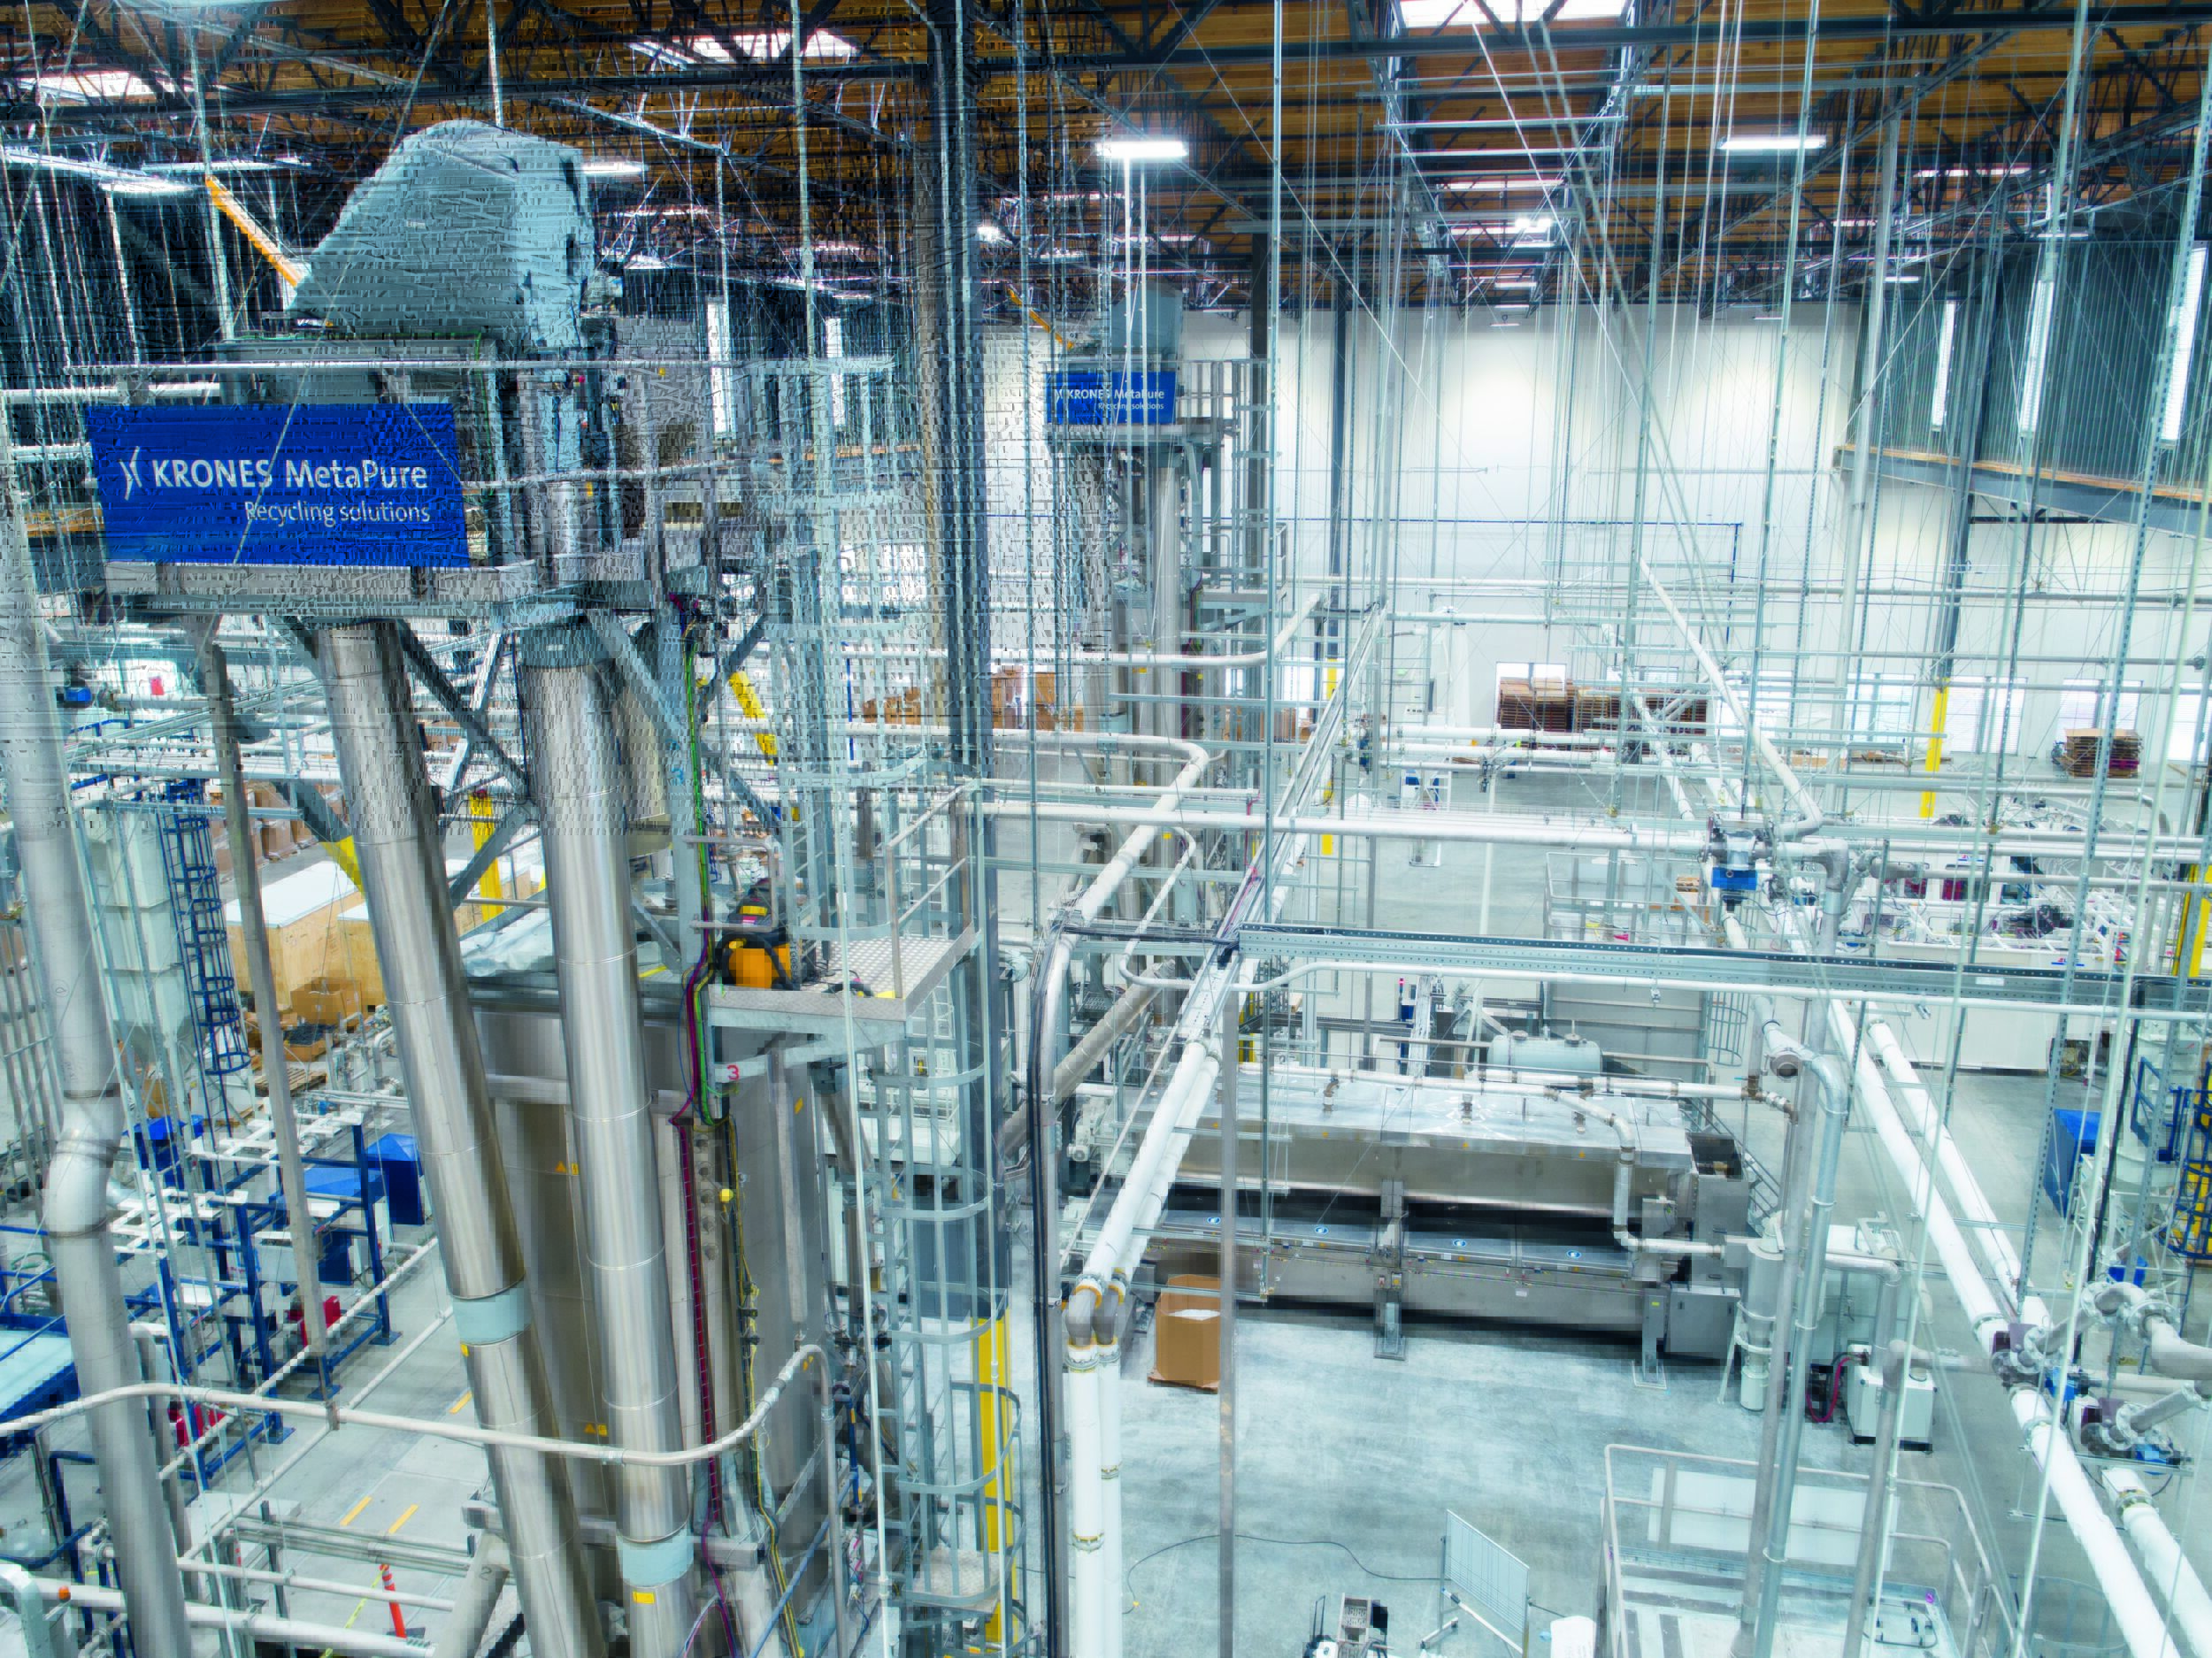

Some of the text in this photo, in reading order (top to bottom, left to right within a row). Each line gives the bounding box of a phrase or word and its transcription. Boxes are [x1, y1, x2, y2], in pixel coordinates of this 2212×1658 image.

[152, 459, 428, 488] KRONES MetaPure
[244, 500, 430, 527] Recycling solutions
[726, 1064, 740, 1080] 3
